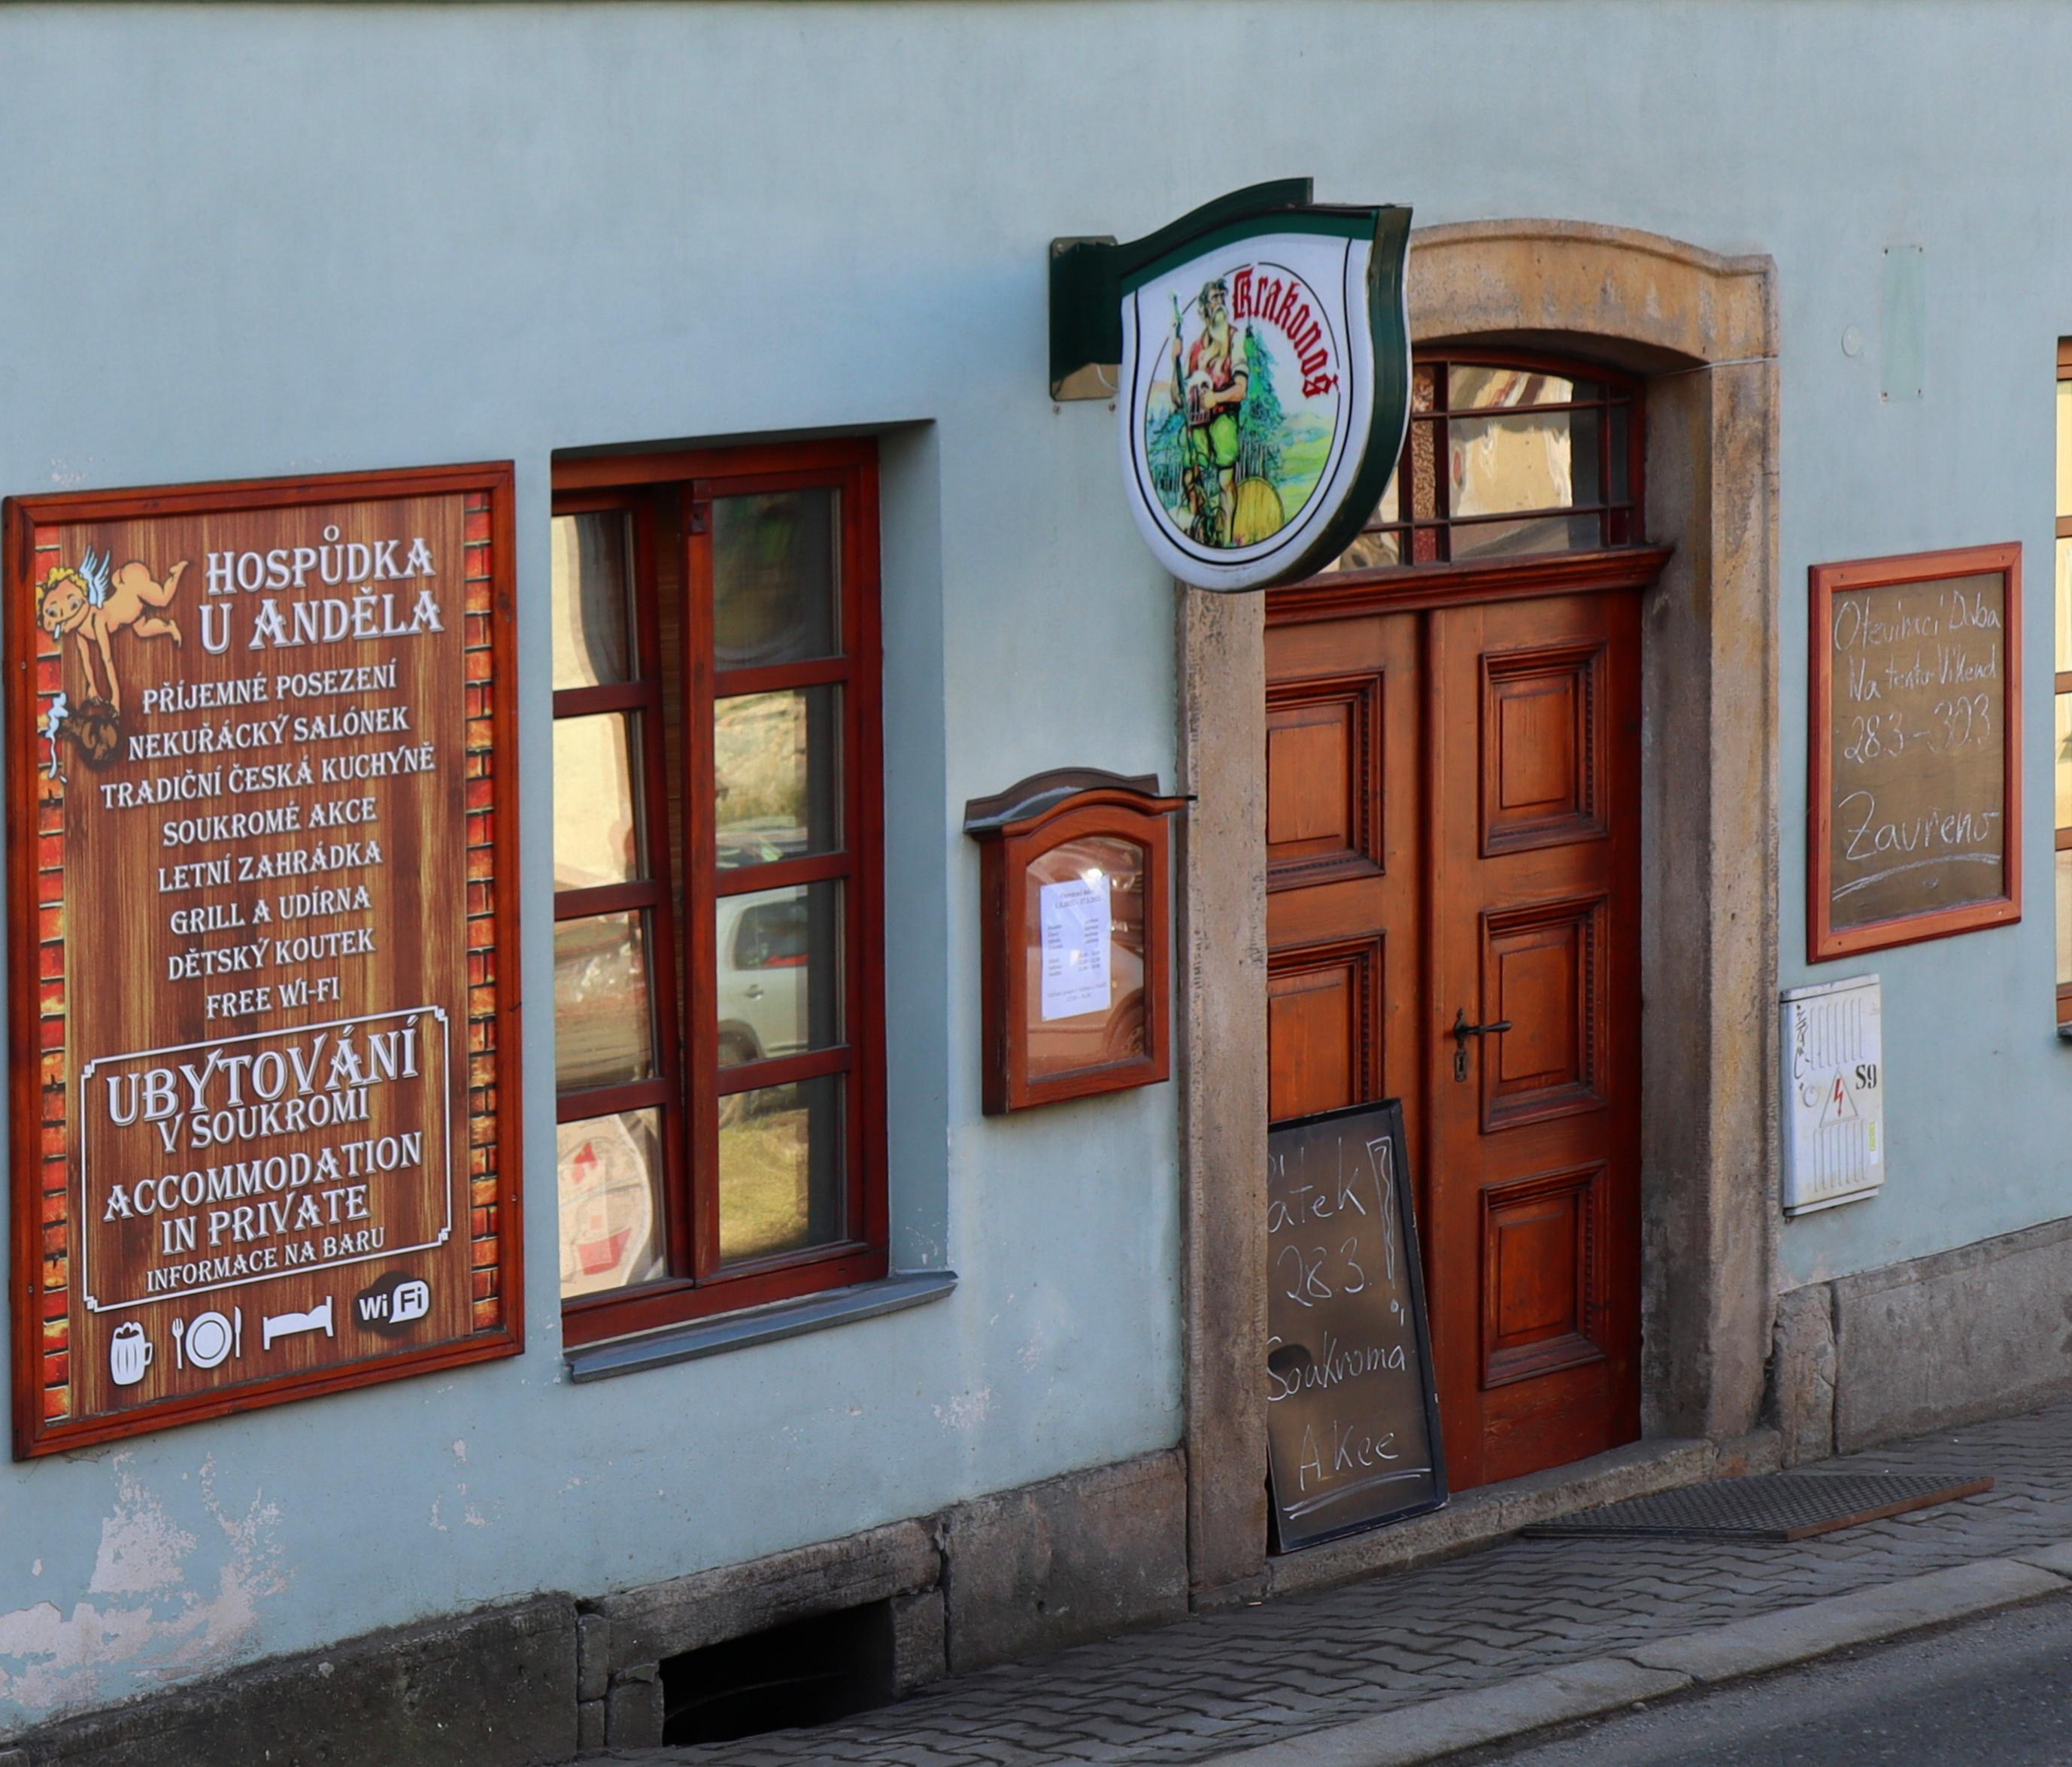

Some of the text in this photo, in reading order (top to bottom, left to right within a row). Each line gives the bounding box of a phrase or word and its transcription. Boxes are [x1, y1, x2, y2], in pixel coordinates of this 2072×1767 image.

[205, 524, 436, 596] HOSPŮDKA
[199, 587, 444, 654] U ANDĚLA
[142, 658, 398, 715] PŘÍJEMNÉ POSEZENÍ
[1849, 654, 1882, 702] Na
[128, 706, 411, 761] NEKUŘÁCKÝ SALÓNEK
[100, 741, 436, 809] TRADIČNÍ ČESKÁ KUCHYNĚ
[162, 796, 378, 848] SOUKROMÉ AKCE
[158, 839, 384, 893] LETNÍ ZAHRÁDKA
[170, 885, 372, 935] GRILL A UDÍRNA
[168, 928, 377, 982] DĚTSKÝ KOUTEK
[206, 976, 341, 1020] FREE WI-FI
[105, 1016, 420, 1127] UBYTOVÁNÍ
[1855, 1064, 1878, 1091] S9
[156, 1112, 184, 1154] V
[103, 1131, 423, 1222] ACCOMMODATION
[162, 1184, 371, 1256] IN PRIVATE
[147, 1227, 386, 1293] INFORMACE NA BARU
